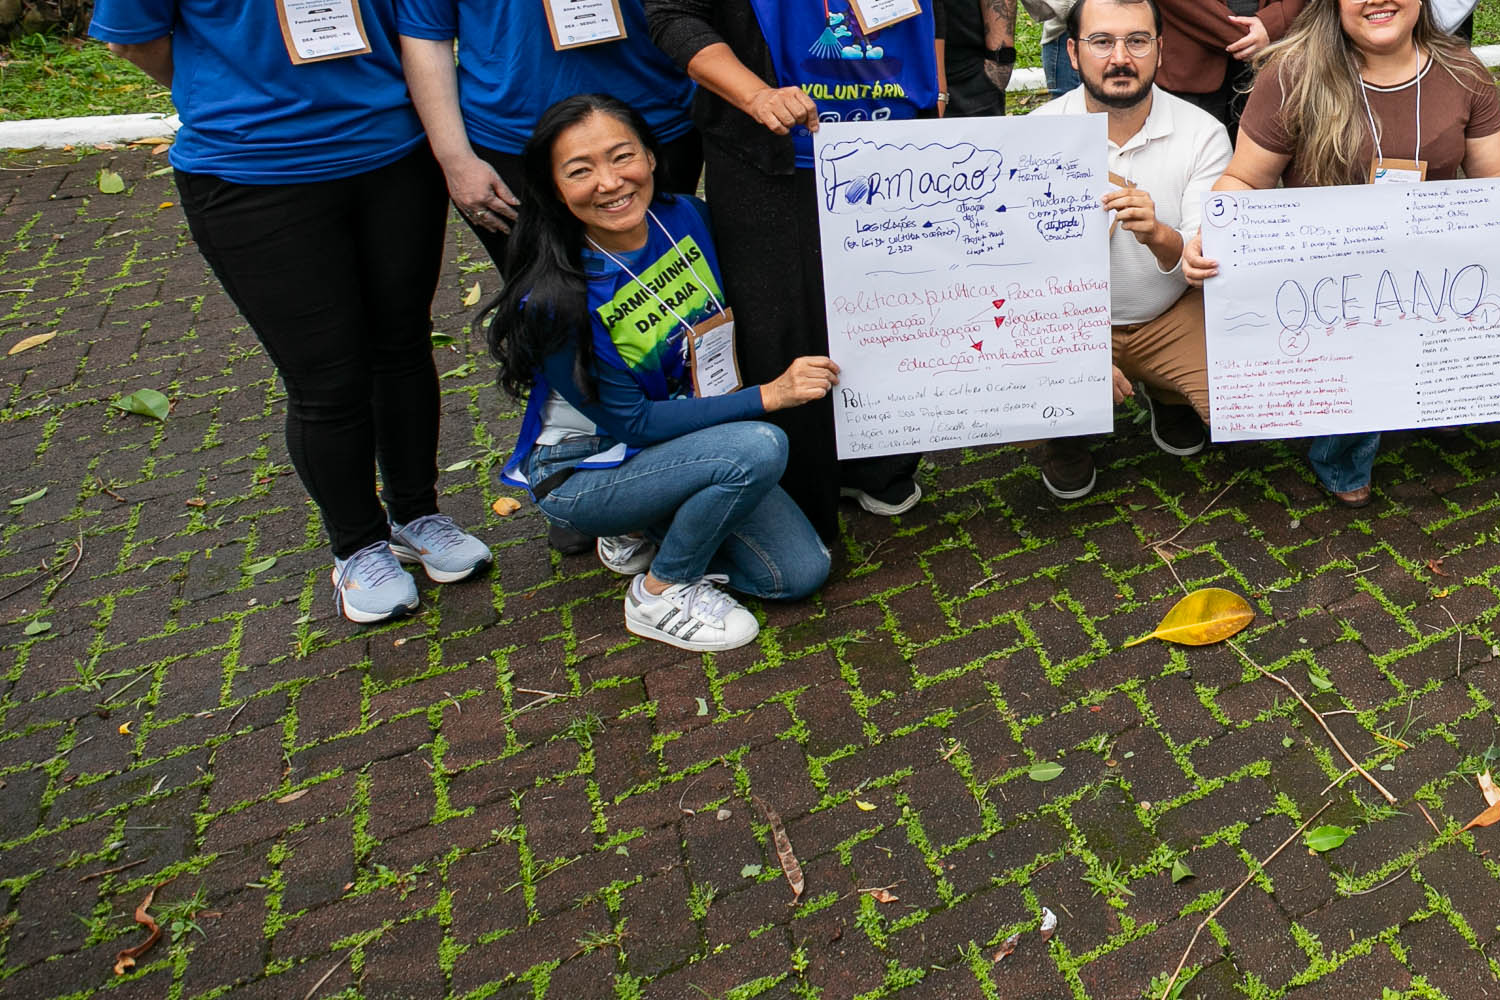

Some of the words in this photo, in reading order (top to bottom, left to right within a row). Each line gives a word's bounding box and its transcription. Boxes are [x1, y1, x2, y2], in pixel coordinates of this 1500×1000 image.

[801, 81, 905, 100] VOLUNTÁRIO
[1212, 198, 1224, 217] 3
[634, 312, 662, 334] DA
[658, 282, 699, 317] PRAIA
[1275, 263, 1488, 334] OCEANO
[1287, 336, 1299, 349] 2
[1042, 405, 1075, 419] ODS
